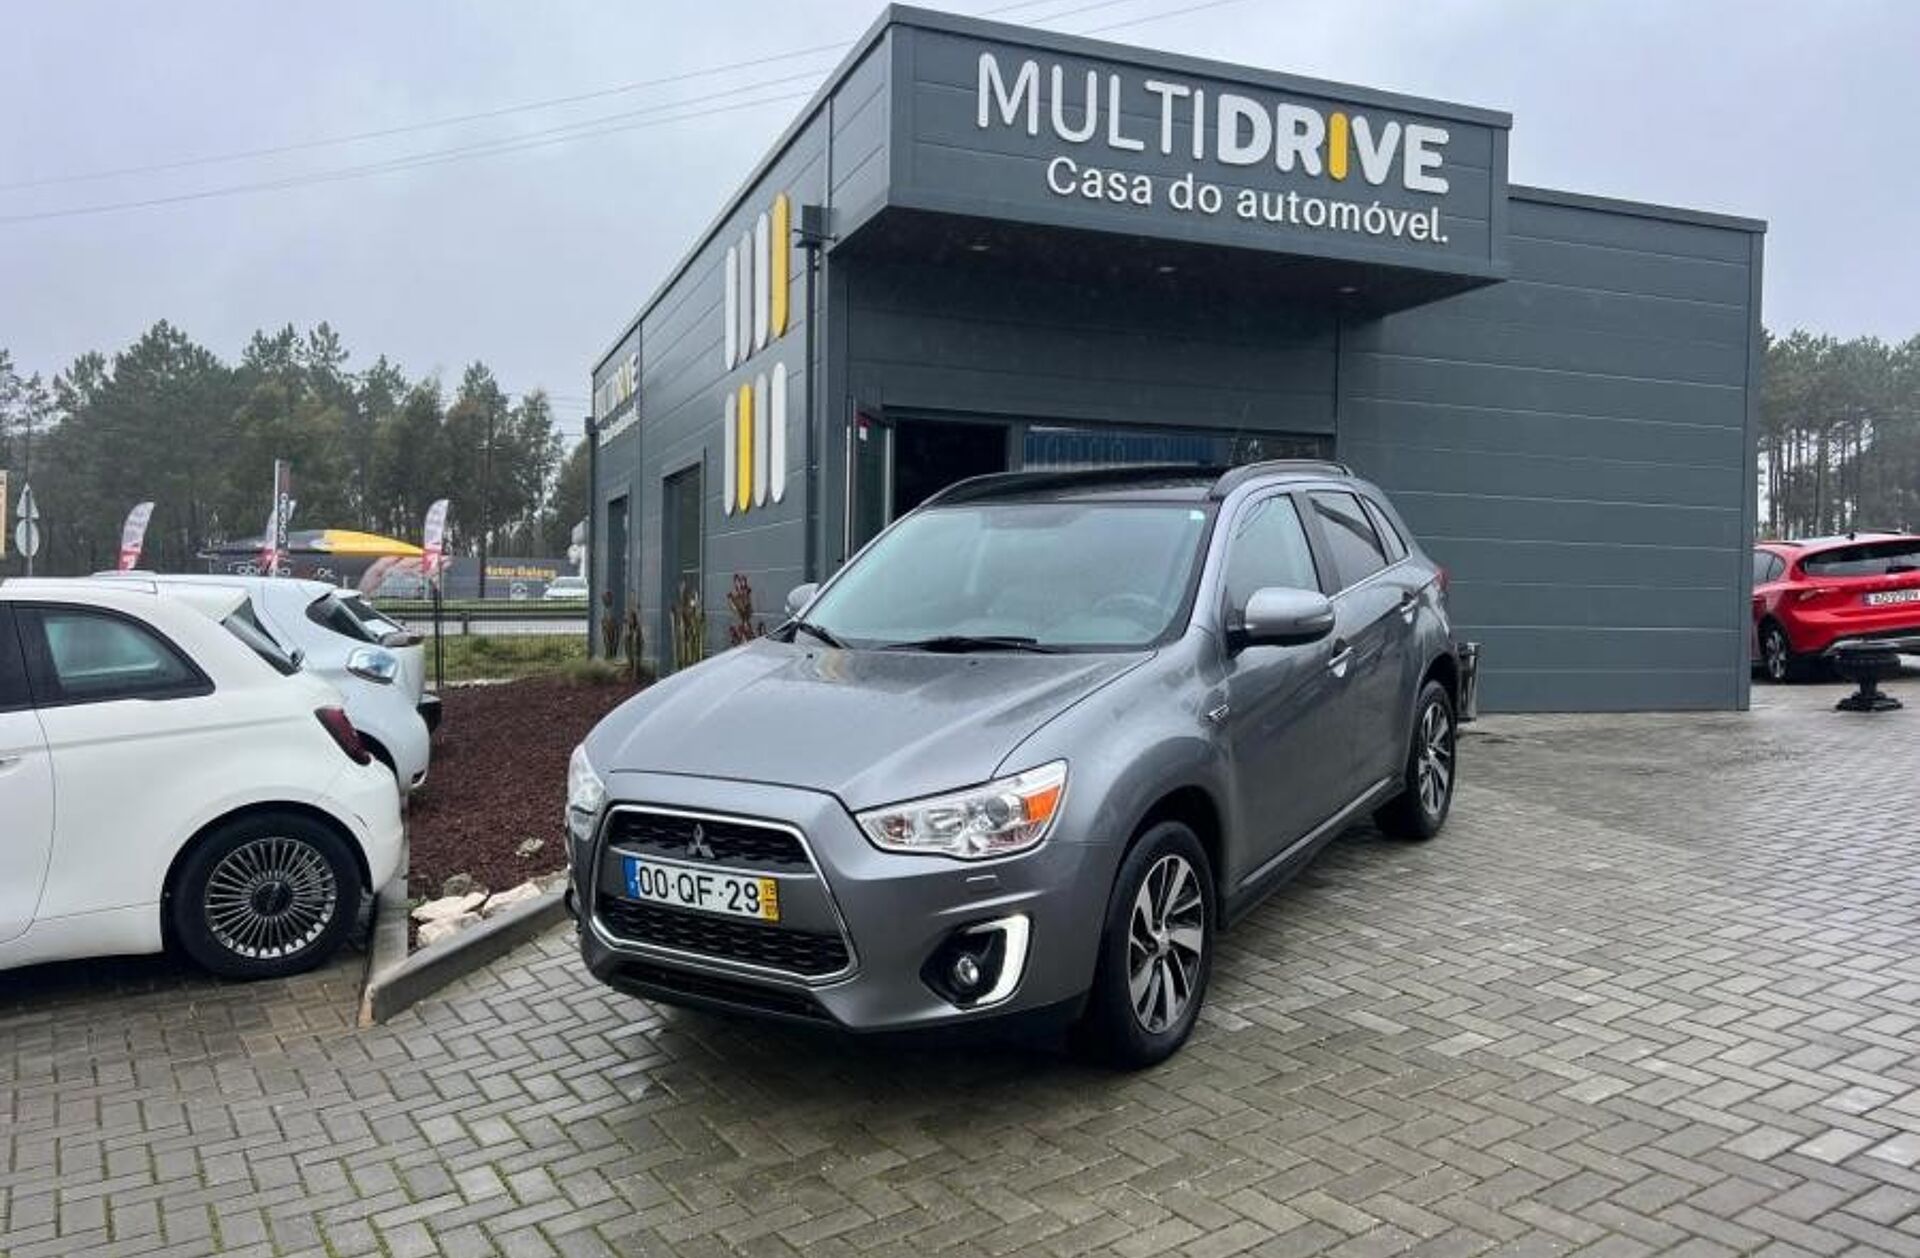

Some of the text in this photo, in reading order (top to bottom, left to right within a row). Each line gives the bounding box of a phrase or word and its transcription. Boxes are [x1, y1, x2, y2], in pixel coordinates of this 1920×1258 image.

[977, 52, 1450, 194] MULTIDRIVE
[1047, 156, 1450, 244] Casa do automóvel.
